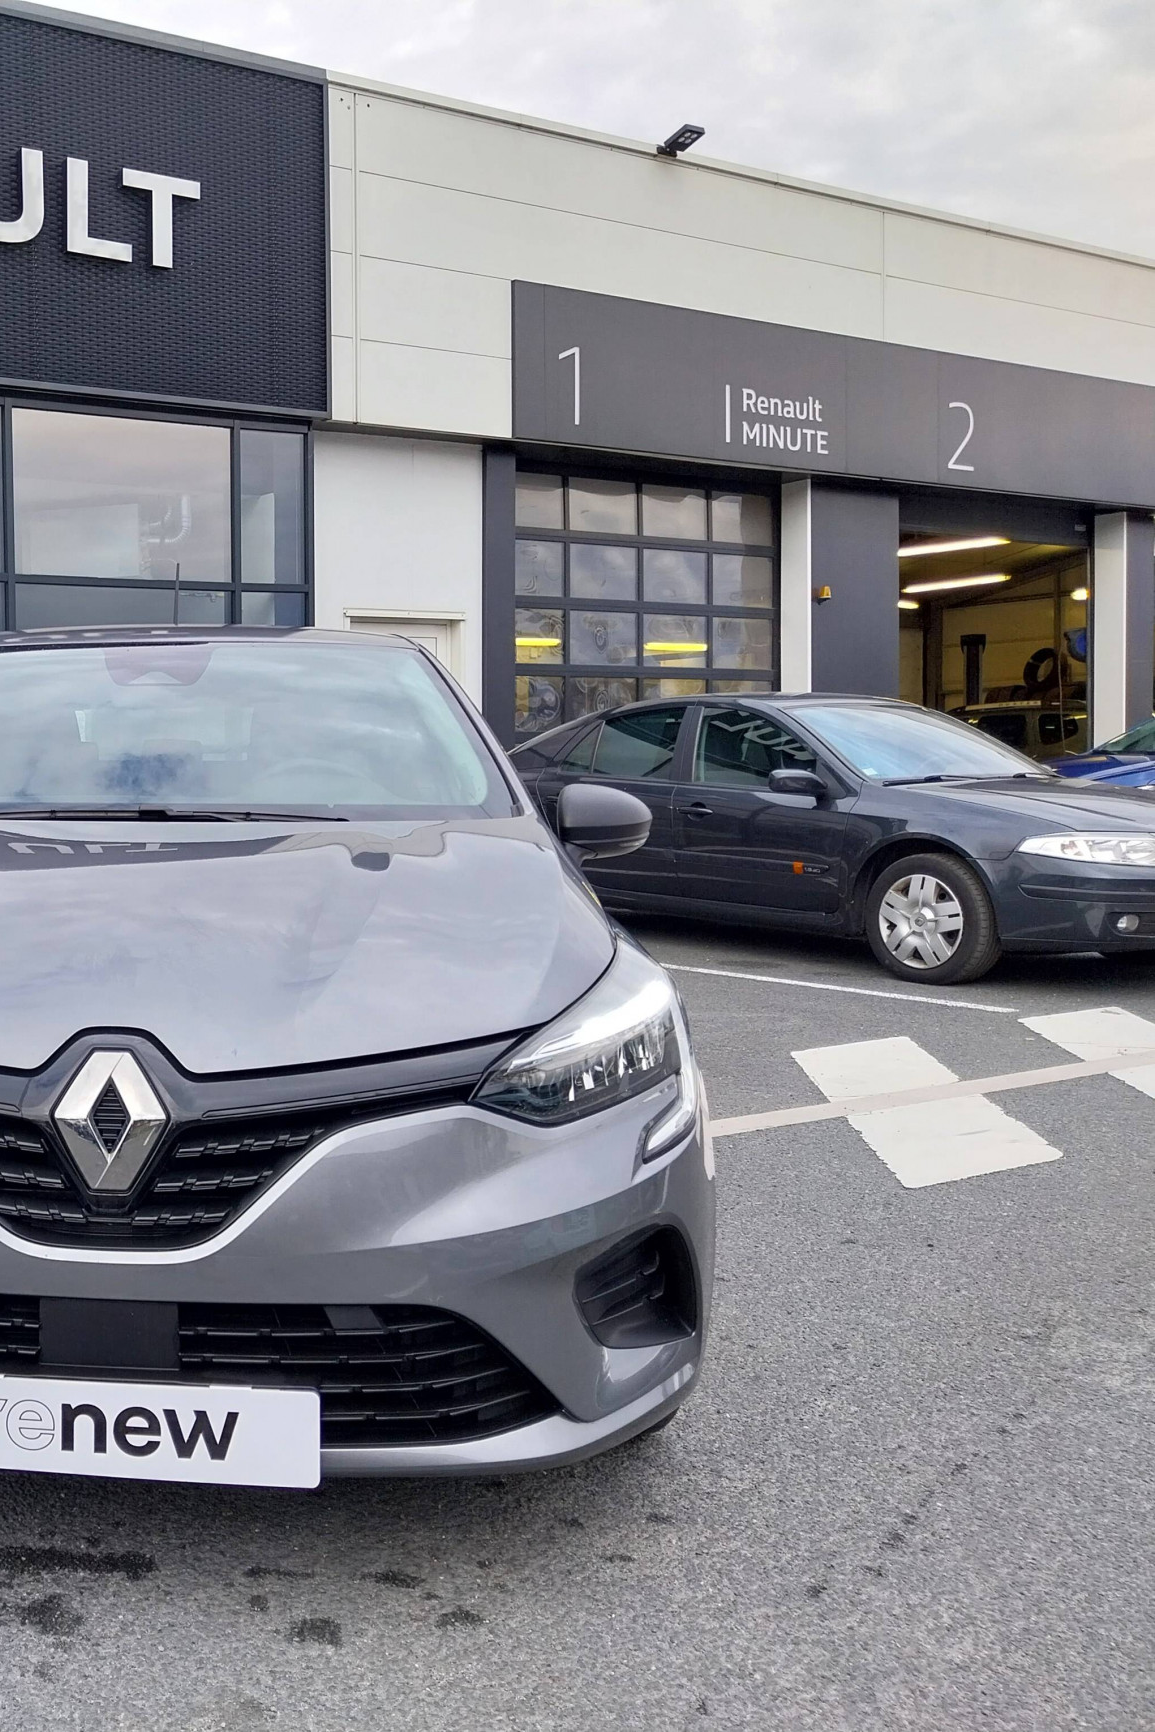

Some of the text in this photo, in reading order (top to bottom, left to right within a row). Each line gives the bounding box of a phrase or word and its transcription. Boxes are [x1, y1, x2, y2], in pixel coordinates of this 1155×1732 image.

[558, 346, 580, 426] 1
[741, 387, 823, 423] Renault
[741, 420, 830, 455] MINUTE
[947, 401, 975, 472] 2
